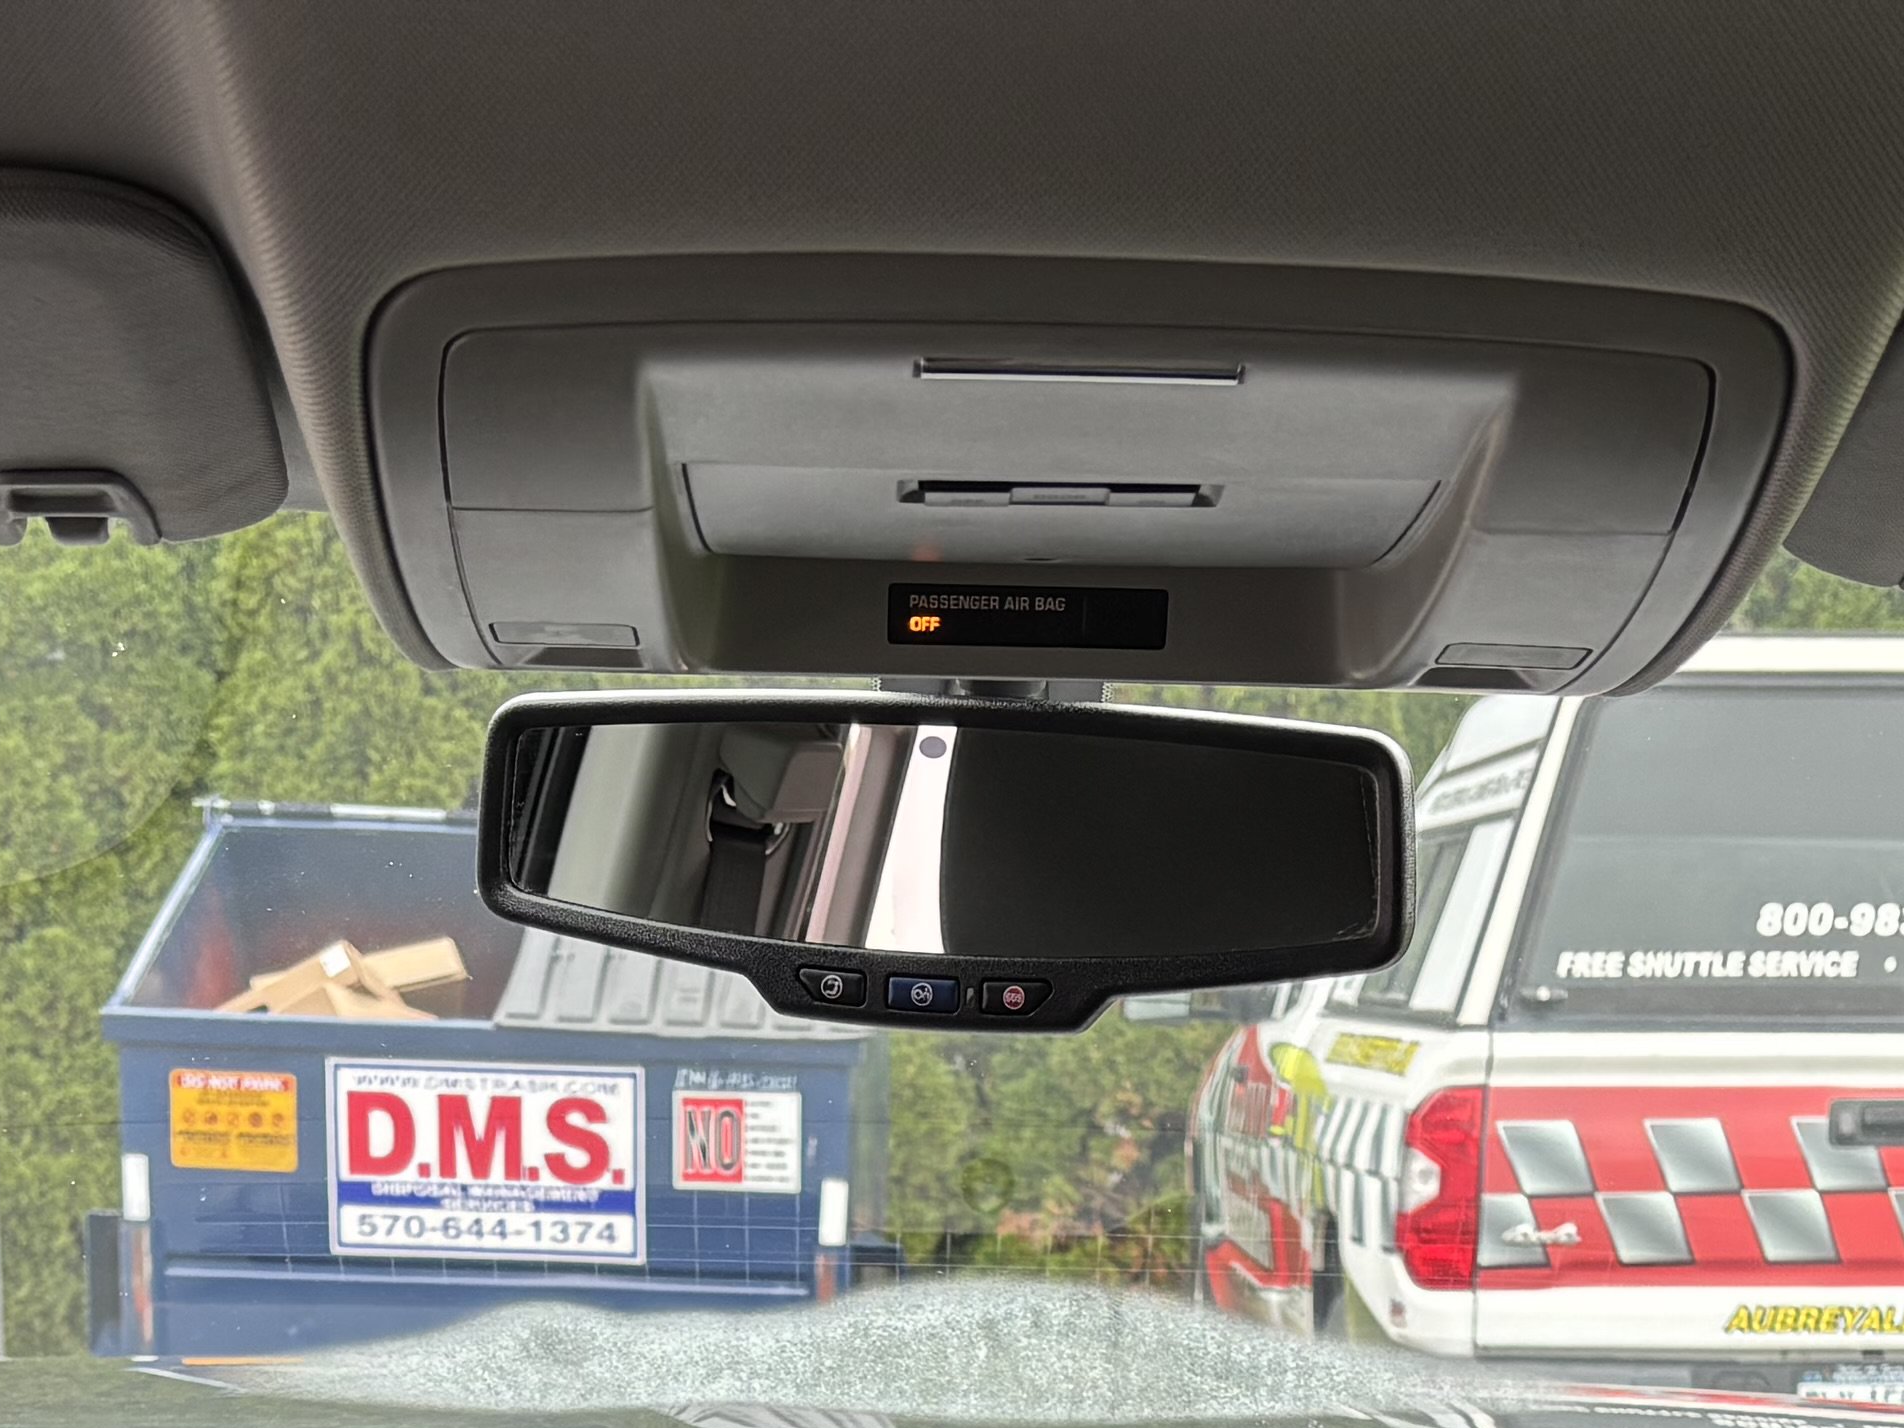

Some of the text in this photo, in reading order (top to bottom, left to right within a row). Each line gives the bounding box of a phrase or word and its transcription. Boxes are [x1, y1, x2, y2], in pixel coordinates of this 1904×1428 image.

[909, 593, 1067, 612] PASSENGER AIR BAG
[909, 616, 940, 632] OFF
[1556, 950, 1859, 978] FREE SHUTTLE SERVICE
[346, 1090, 626, 1186] D.M.S.
[683, 1107, 739, 1174] NO
[356, 1213, 620, 1247] 570-644-1374
